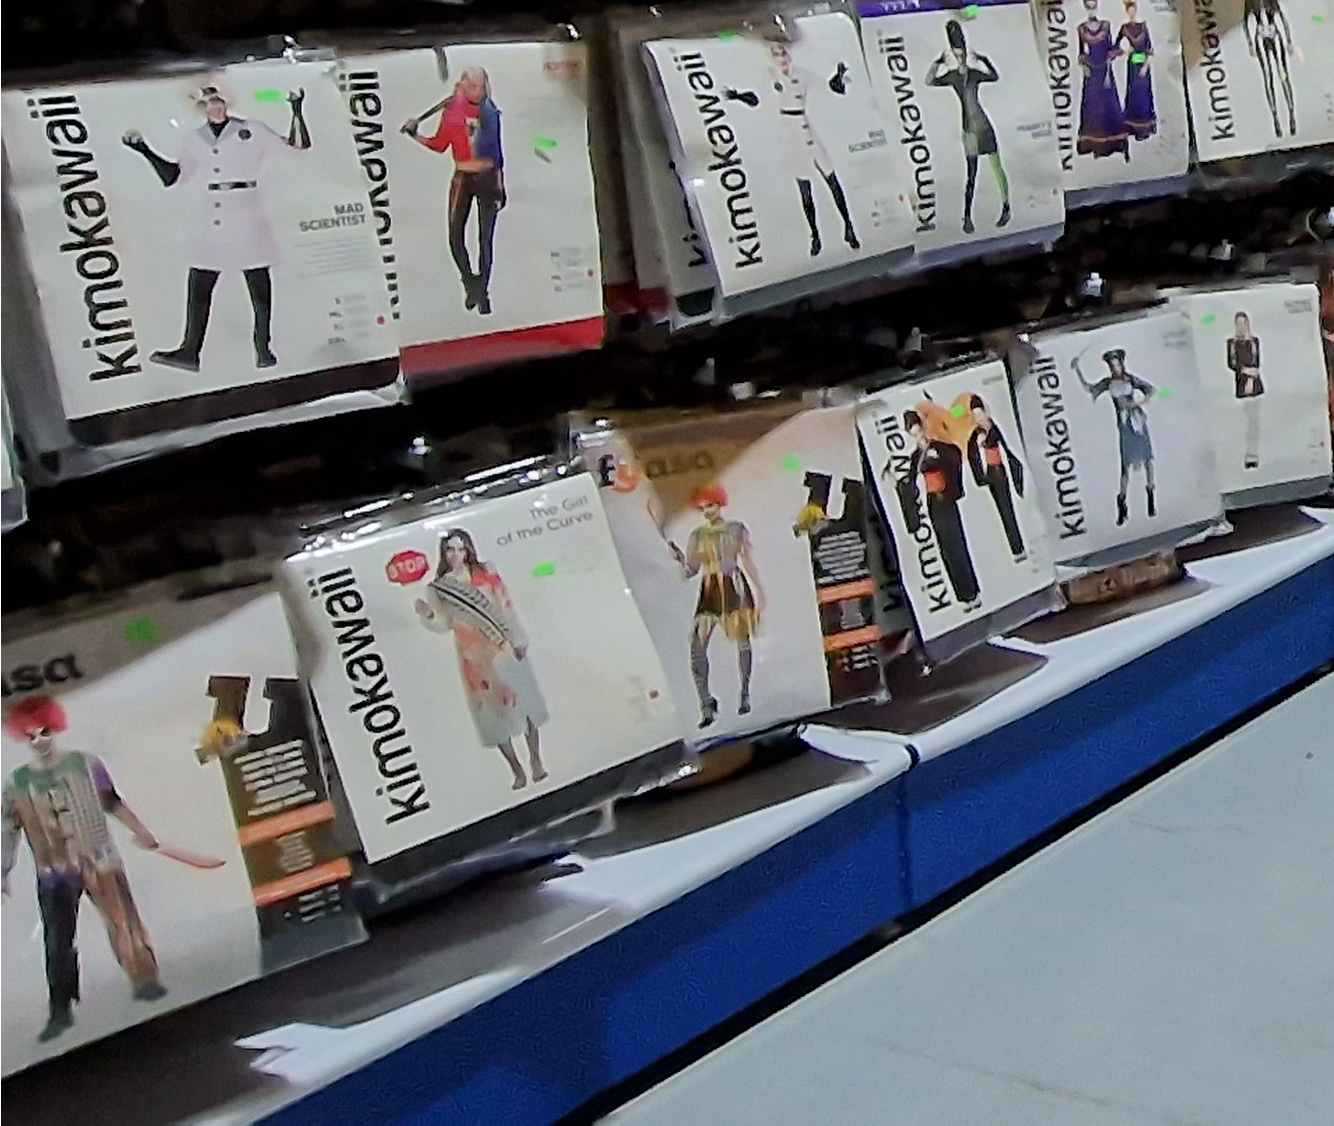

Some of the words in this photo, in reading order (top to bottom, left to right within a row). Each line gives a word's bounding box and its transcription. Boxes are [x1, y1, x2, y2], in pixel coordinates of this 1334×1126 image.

[299, 214, 366, 232] SCIENTIST
[333, 202, 364, 215] MAD
[670, 46, 764, 270] kimokawaii
[876, 29, 938, 234] kimokawaii
[26, 91, 143, 382] kimokawaii
[530, 505, 558, 520] The
[547, 510, 593, 532] Curve
[1030, 354, 1088, 542] kimokawaii
[306, 566, 432, 825] kimokawaii
